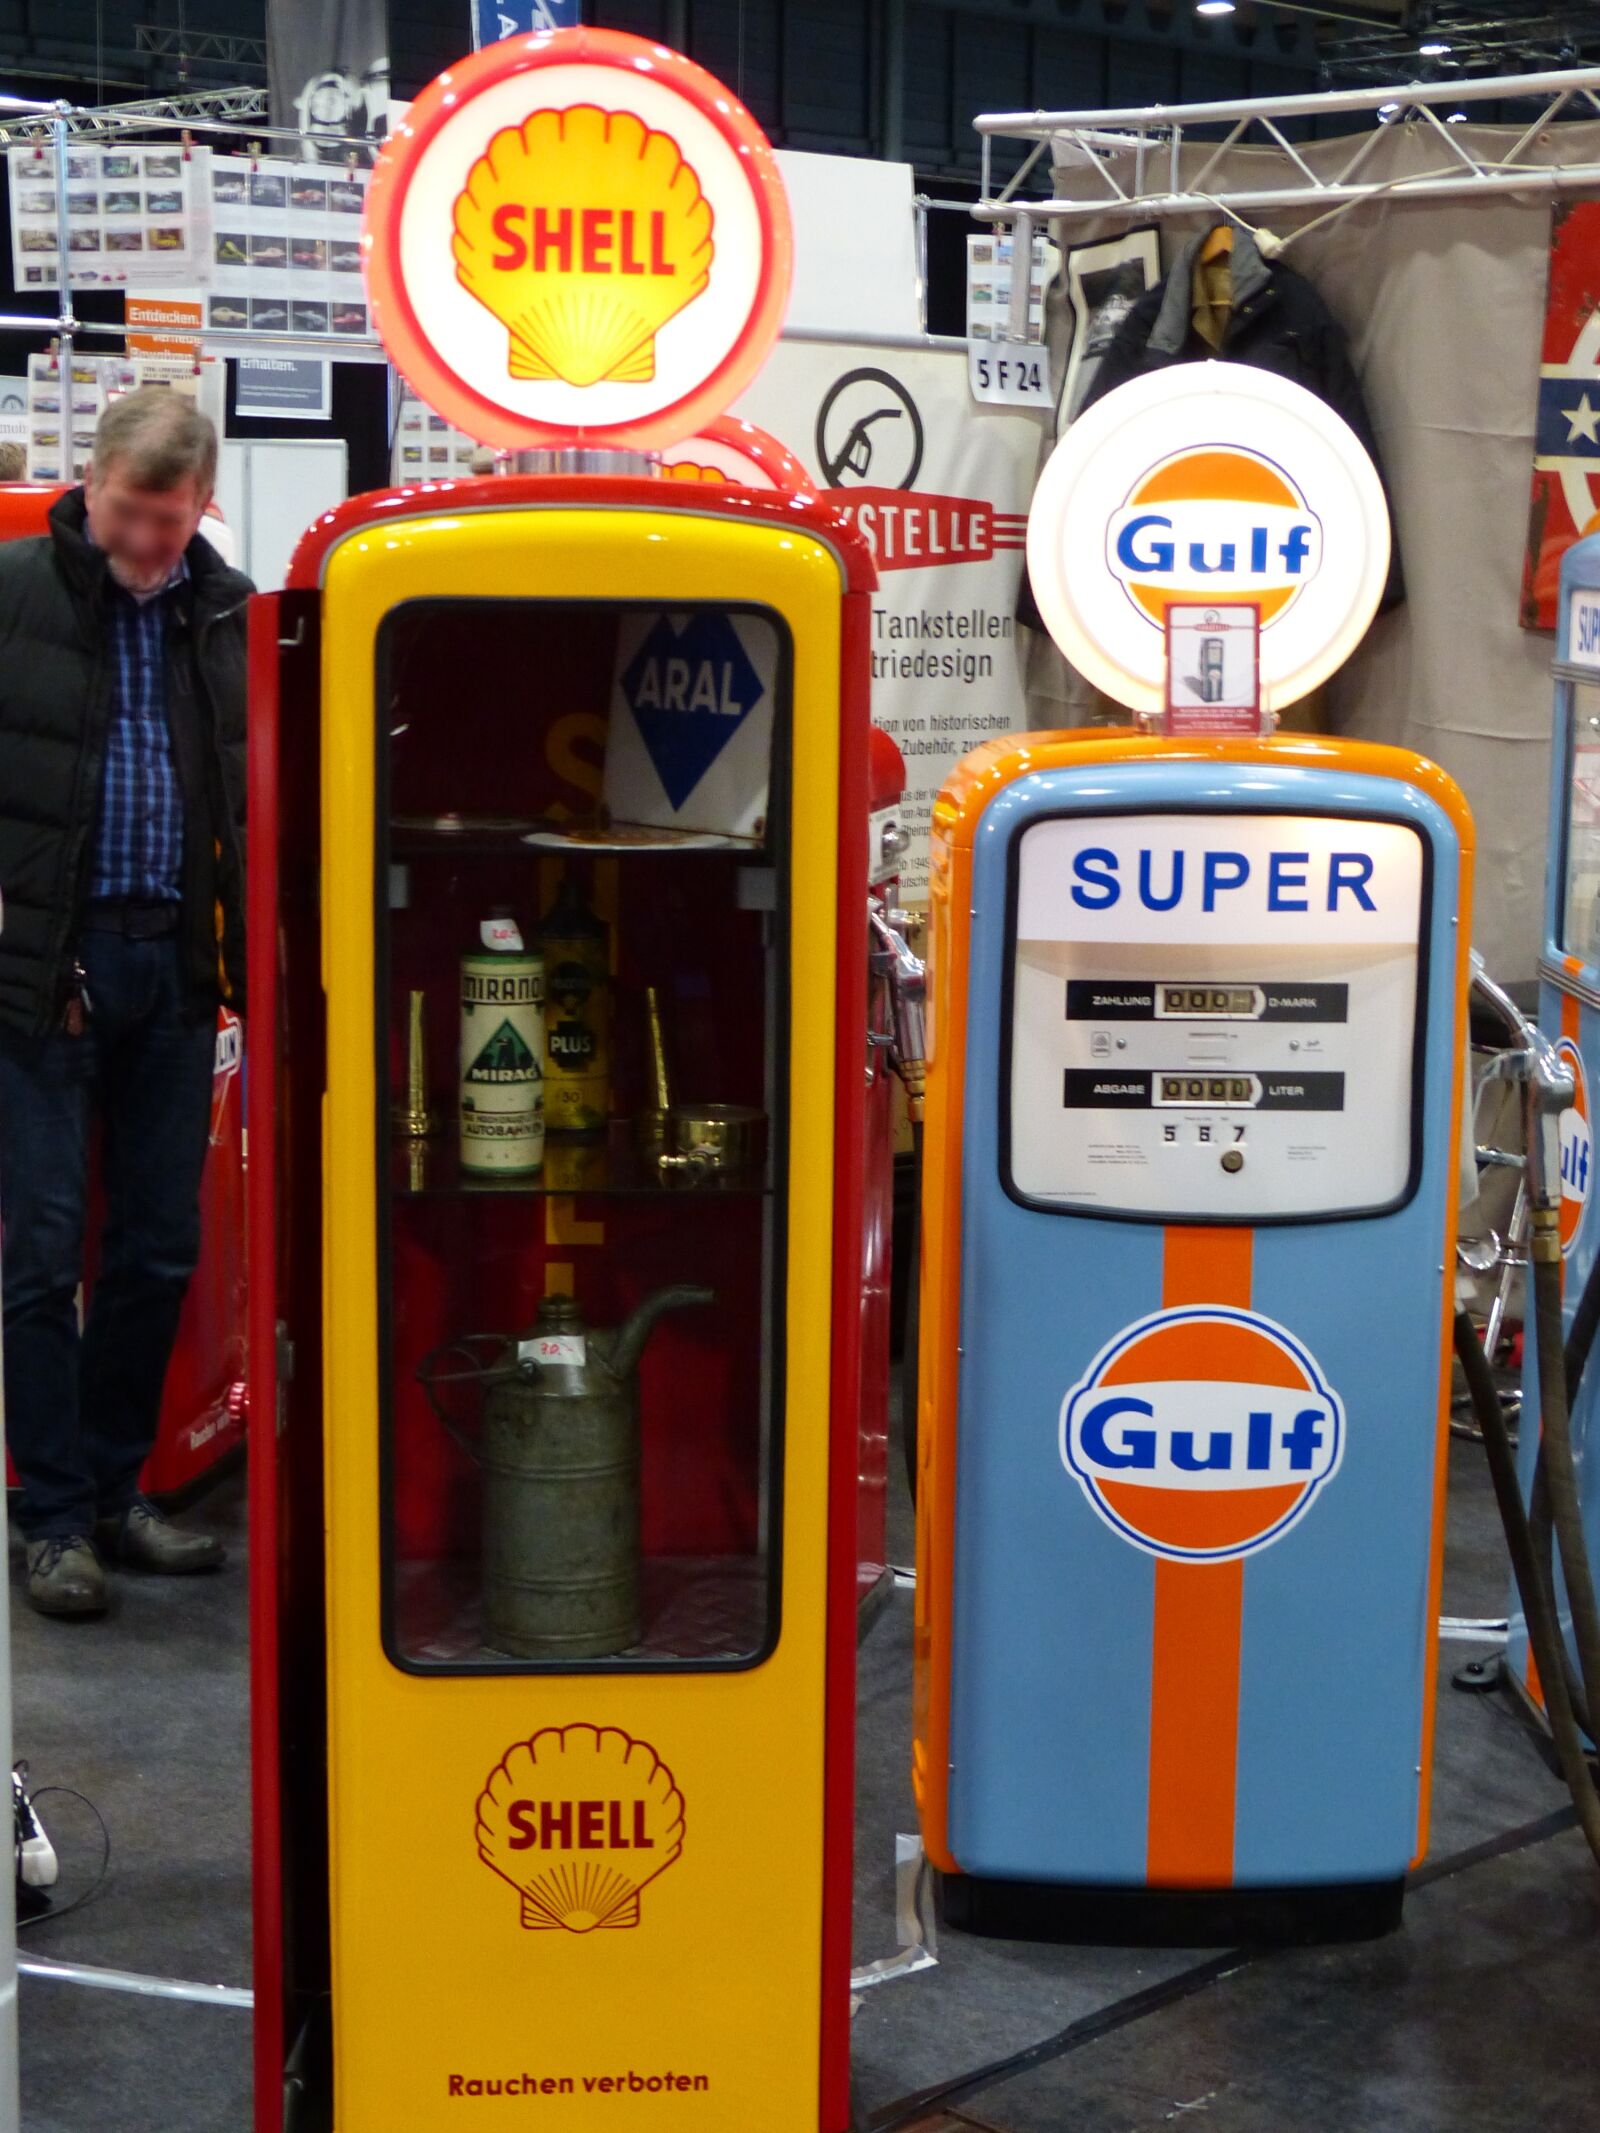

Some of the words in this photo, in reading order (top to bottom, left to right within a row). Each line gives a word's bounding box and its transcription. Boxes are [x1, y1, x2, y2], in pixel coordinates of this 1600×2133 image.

[491, 203, 676, 276] SHELL
[977, 359, 990, 388] 5
[999, 361, 1008, 389] F
[1016, 362, 1041, 392] 24
[833, 504, 987, 558] STELLE
[1116, 515, 1312, 574] Gulf
[872, 609, 1012, 638] Tankstellen
[634, 656, 744, 716] ARAL
[903, 720, 926, 732] von
[930, 713, 1011, 731] historischen
[1071, 847, 1377, 912] SUPER
[1092, 995, 1152, 1006] ZAHLUNG
[1268, 996, 1317, 1008] D-MARK
[550, 1036, 592, 1053] PLUS
[1093, 1084, 1145, 1095] ABGABE
[1268, 1086, 1304, 1096] LITER
[1080, 1397, 1326, 1471] Gulf
[508, 1799, 654, 1850] SHELL
[448, 2074, 574, 2097] Rauchen
[582, 2071, 710, 2095] verboten
